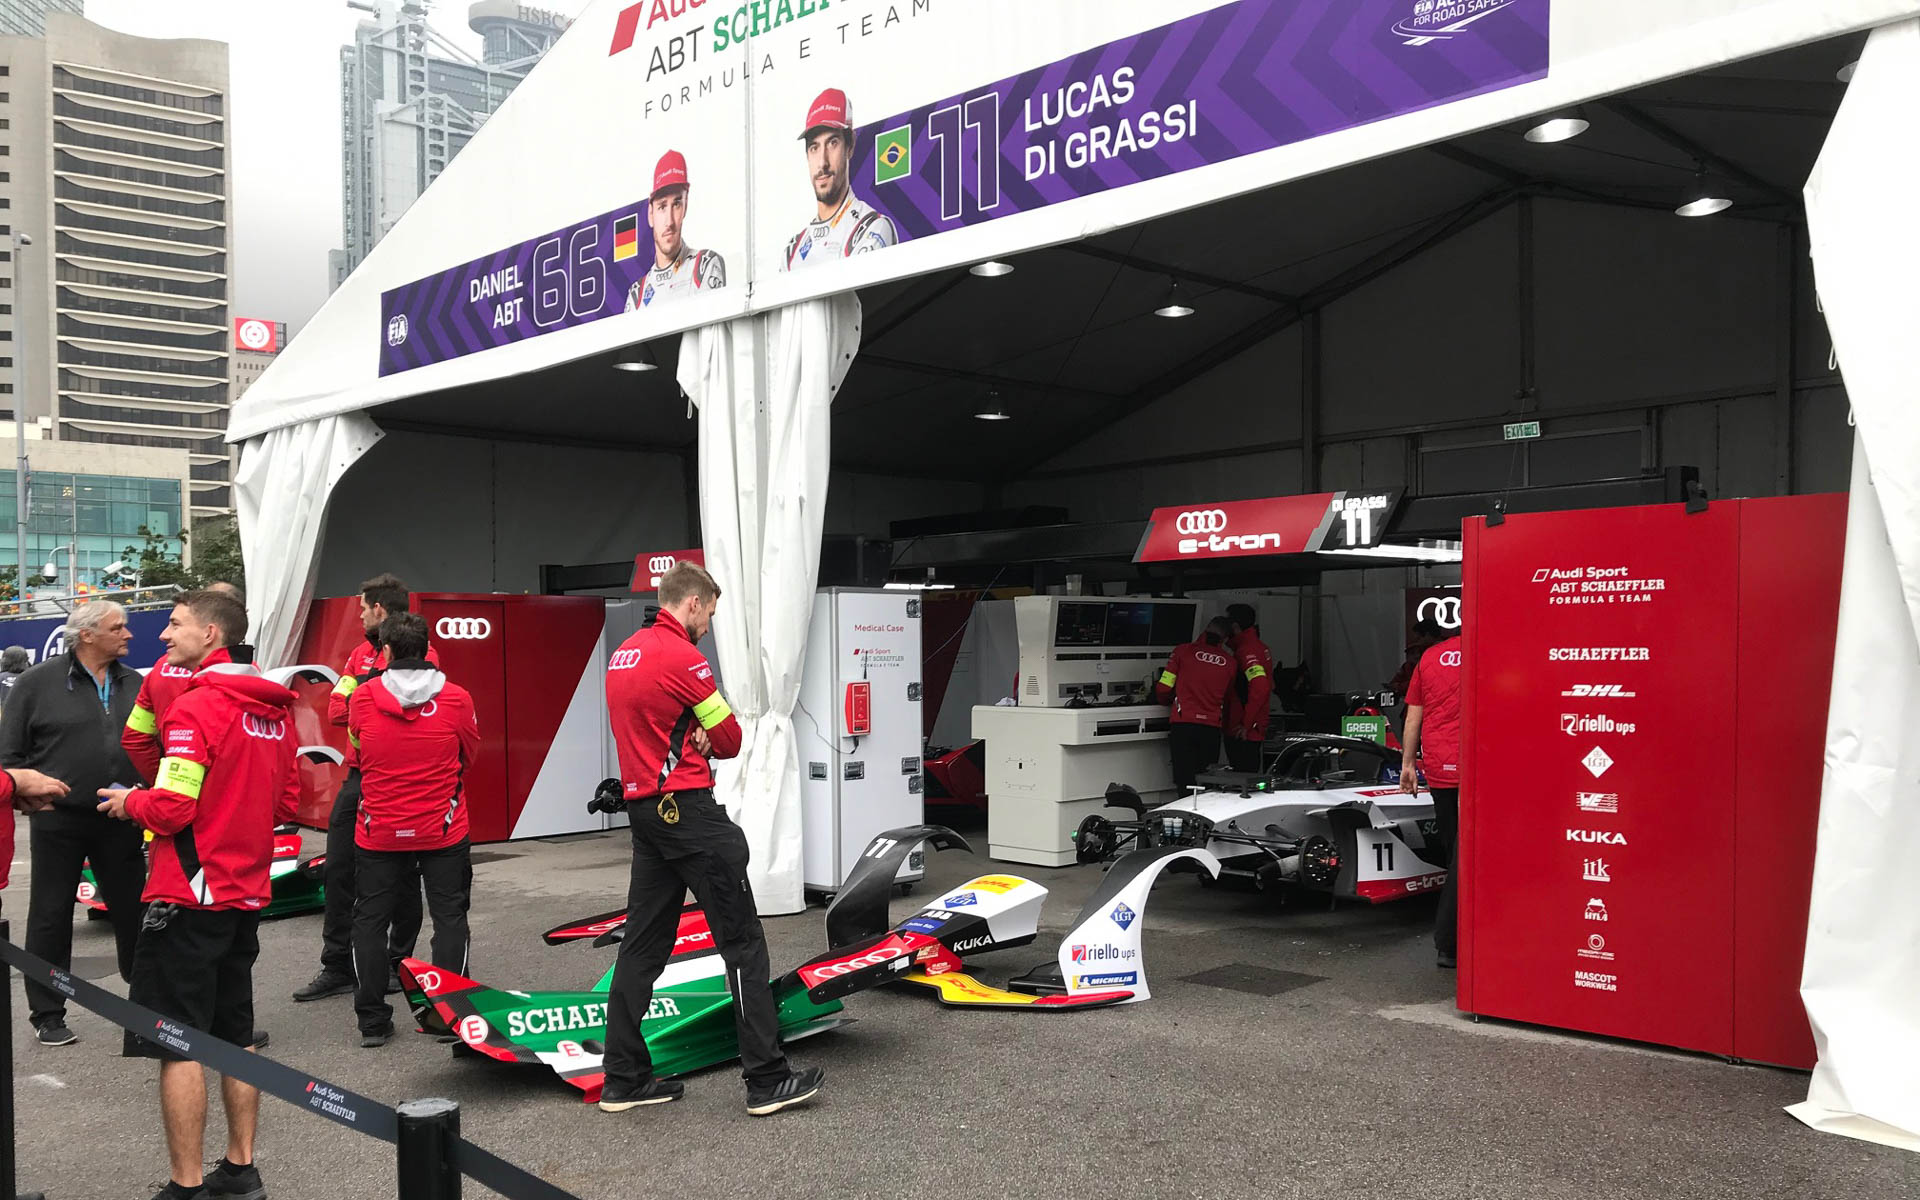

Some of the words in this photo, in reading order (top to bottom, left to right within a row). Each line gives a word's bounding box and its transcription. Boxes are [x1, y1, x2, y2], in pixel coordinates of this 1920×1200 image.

[517, 5, 565, 29] HSBC
[1413, 14, 1431, 26] FOR
[1432, 4, 1466, 24] ROAD
[645, 53, 774, 119] FORMULA
[799, 38, 811, 59] E
[837, 0, 931, 44] TEAM
[646, 25, 704, 82] ABT
[1024, 66, 1135, 132] LUCAS
[1024, 140, 1055, 181] DI
[1064, 99, 1197, 169] GRASSI
[928, 92, 999, 221] 11
[470, 264, 524, 303] DANIEL
[533, 224, 606, 327] 66
[493, 297, 524, 329] ABT
[388, 322, 407, 341] FIA
[1505, 424, 1524, 438] EXIT
[1331, 500, 1343, 512] DI
[1344, 496, 1387, 510] GRASSI
[1341, 509, 1371, 546] 11
[1178, 533, 1281, 553] e-tron
[1550, 567, 1583, 579] Audi
[1586, 566, 1629, 580] Sport
[1549, 582, 1578, 593] ABT
[1580, 579, 1665, 592] SCHAEFFLER
[1549, 595, 1605, 605] FORMULA
[1608, 595, 1615, 603] E
[1619, 594, 1652, 603] TEAM
[854, 624, 885, 633] Medical
[886, 624, 905, 633] Case
[1548, 647, 1650, 660] SCHAEFFLER
[1571, 684, 1626, 697] DHL
[1380, 692, 1395, 707] DIG
[1346, 723, 1378, 733] GREEN
[1579, 714, 1614, 732] riello
[1615, 723, 1636, 735] ups
[1587, 758, 1609, 767] LGT
[1566, 829, 1628, 845] KUKA
[866, 837, 898, 859] 11
[1372, 843, 1394, 871] 11
[1582, 857, 1610, 877] itk
[79, 885, 90, 896] E
[1405, 874, 1449, 891] e-tro
[1114, 911, 1134, 922] LGT
[953, 934, 993, 952] KUKA
[1088, 943, 1119, 960] riello
[1121, 949, 1136, 960] ups
[1091, 975, 1134, 985] MICHELIN
[1574, 979, 1617, 992] WORKWEAR
[161, 1020, 173, 1031] Audi
[171, 1025, 185, 1037] Sport
[467, 1019, 482, 1039] E
[165, 1036, 191, 1052] SCHAEFFLER
[563, 1044, 580, 1057] E
[313, 1083, 327, 1098] Audi
[326, 1088, 345, 1104] Sport
[309, 1095, 322, 1108] ABT
[321, 1100, 356, 1122] SCHAEFFLER
